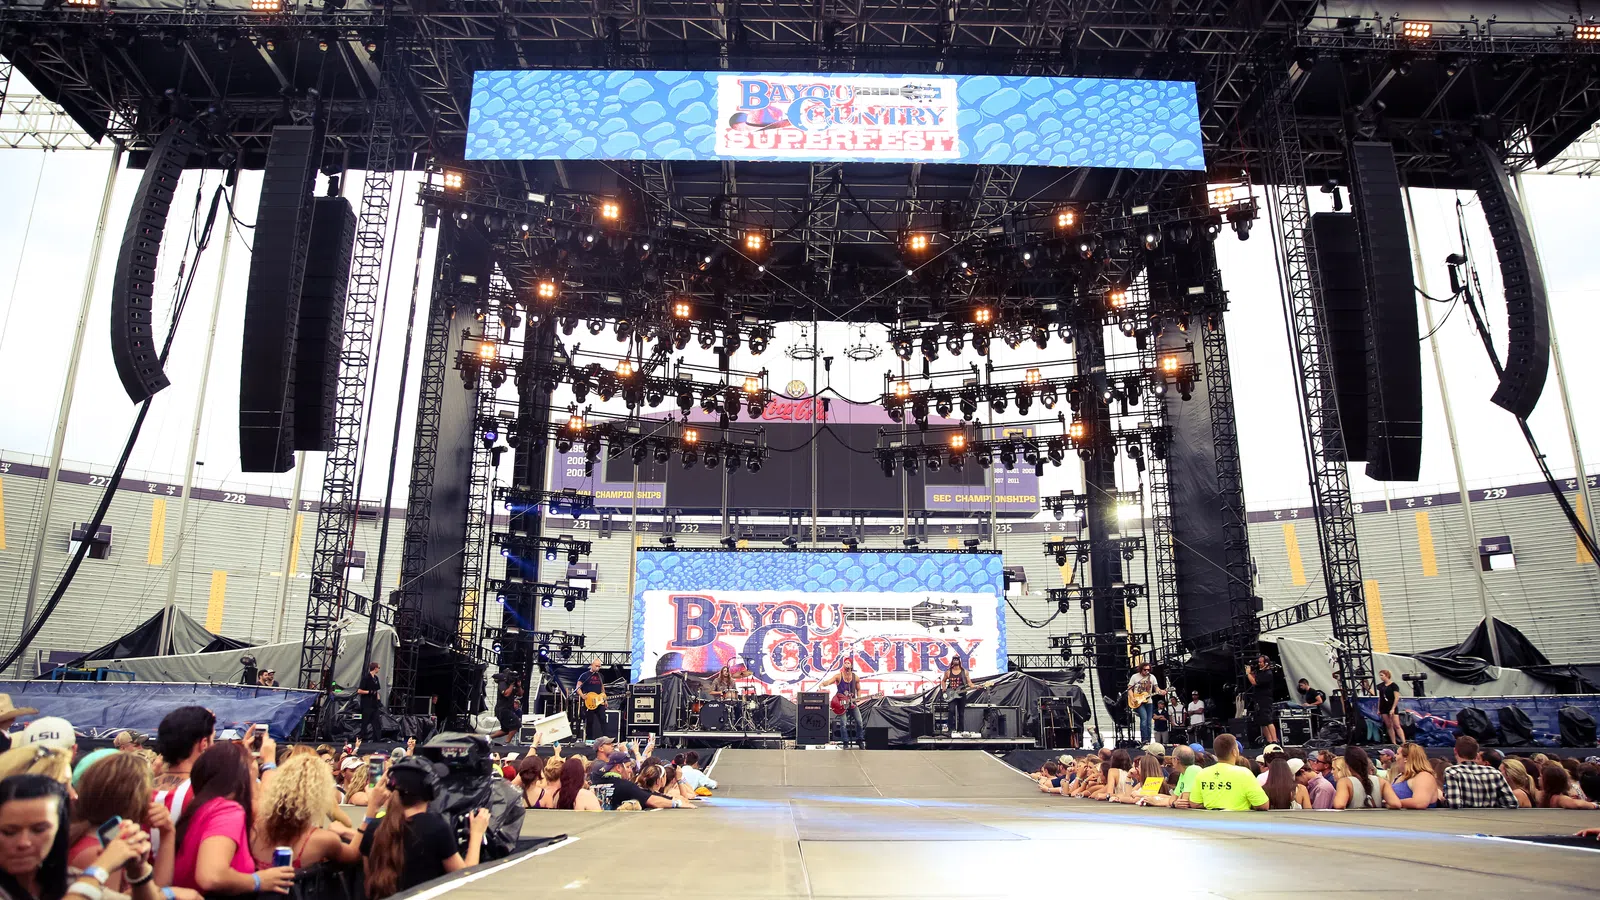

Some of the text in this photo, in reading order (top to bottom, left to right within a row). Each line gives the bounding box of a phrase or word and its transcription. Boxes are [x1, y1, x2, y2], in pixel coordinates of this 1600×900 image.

[738, 79, 855, 110] BAYOU
[785, 96, 947, 131] COUNTRY
[726, 128, 957, 151] SUPERFEST
[223, 492, 247, 504] 228
[595, 491, 662, 499] CHAMPIOSHIPS
[933, 494, 952, 503] SEC
[1483, 488, 1507, 500] 239
[573, 520, 591, 530] 231
[681, 524, 699, 533] 232
[995, 524, 1013, 533] 235
[668, 594, 843, 650] BAYOU
[738, 622, 982, 685] COUNTRY
[30, 731, 60, 743] LSU
